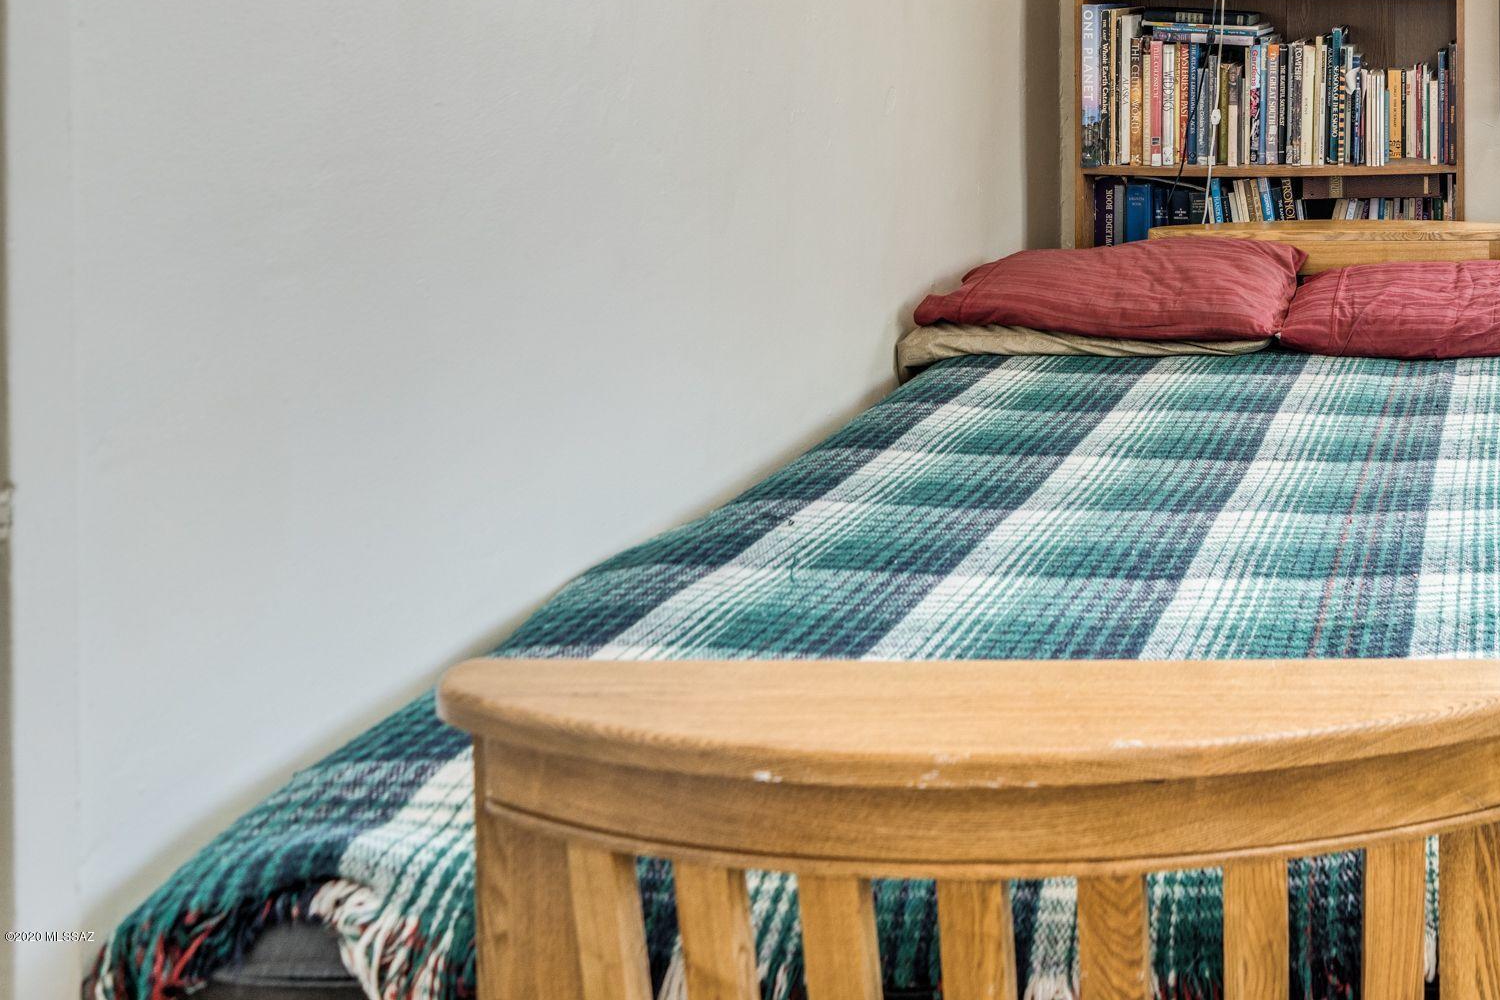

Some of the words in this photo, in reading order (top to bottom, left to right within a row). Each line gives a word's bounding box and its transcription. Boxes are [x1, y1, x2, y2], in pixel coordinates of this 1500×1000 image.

[1082, 9, 1095, 40] ONE
[1101, 42, 1110, 64] Whole
[1130, 43, 1140, 62] THE
[1190, 56, 1198, 73] ATLAS
[1082, 47, 1095, 102] PLANET
[1101, 65, 1110, 87] Earth
[1130, 64, 1141, 94] CELTIC
[1180, 47, 1190, 91] MYSTERIES
[1250, 49, 1259, 87] Gardens
[1268, 61, 1277, 75] THE
[1332, 64, 1340, 92] SEASONS
[1122, 77, 1130, 105] ALASKA
[1268, 76, 1278, 99] GREAT
[1279, 75, 1287, 98] BEAUTIFUL
[1100, 87, 1110, 114] Catalog
[1180, 100, 1189, 118] PAST
[1130, 99, 1140, 134] WORLD
[1267, 101, 1278, 146] SOUTHEST
[1330, 113, 1339, 138] ESKIMO
[1198, 127, 1206, 146] Triangle
[1105, 188, 1113, 210] BOOK
[1281, 178, 1296, 219] PRONOI
